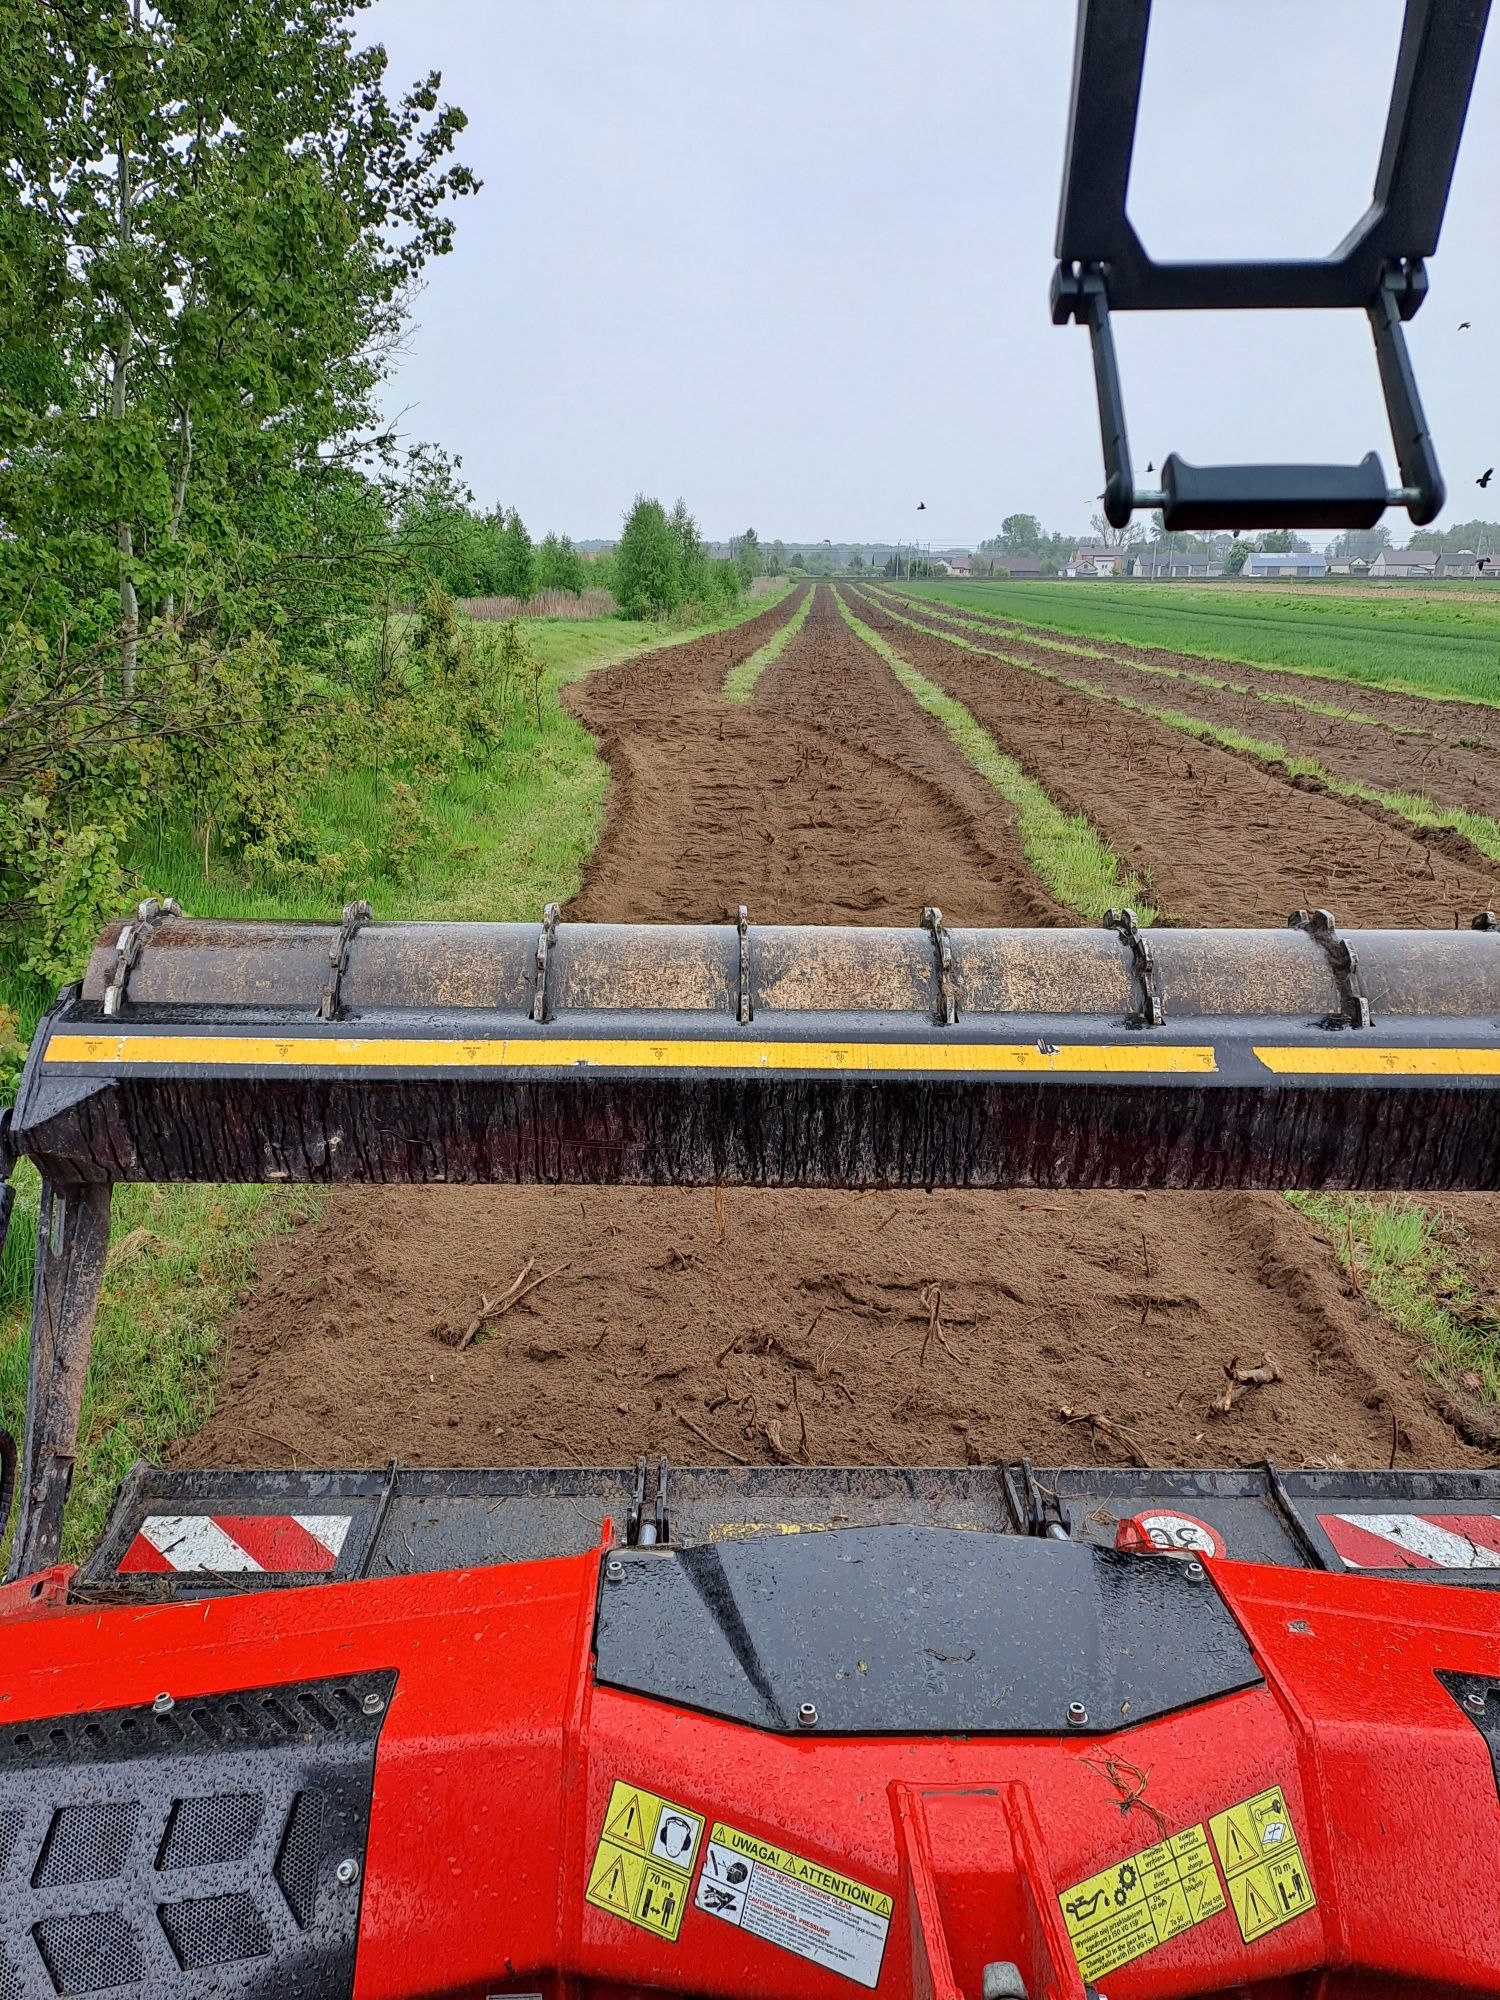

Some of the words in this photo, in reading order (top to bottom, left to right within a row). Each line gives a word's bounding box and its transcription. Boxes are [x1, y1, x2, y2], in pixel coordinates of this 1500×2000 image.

[731, 1835, 780, 1865] UWAGA!
[1187, 1852, 1199, 1862] Next
[1187, 1859, 1203, 1871] change
[1273, 1866, 1282, 1876] 70
[1283, 1863, 1291, 1872] m
[649, 1872, 661, 1886] 70
[662, 1880, 671, 1889] m
[1153, 1869, 1165, 1880] First
[799, 1864, 874, 1906] ATTENTION!
[1153, 1876, 1170, 1889] change
[1212, 1894, 1222, 1903] 500
[1150, 1903, 1157, 1911] 50
[747, 1894, 772, 1910] CAUTION
[772, 1906, 788, 1917] HIGH
[788, 1913, 797, 1921] OIL
[798, 1917, 830, 1936] PRESSURE!
[1170, 1917, 1177, 1926] To
[1176, 1914, 1183, 1922] 50
[1111, 1928, 1121, 1938] ISO
[1121, 1923, 1129, 1932] VG
[1129, 1918, 1139, 1928] 150
[1085, 1953, 1105, 1969] Change
[1116, 1942, 1126, 1952] the
[1126, 1937, 1137, 1947] gear
[1137, 1931, 1146, 1940] box
[1088, 1957, 1116, 1977] accordance
[1115, 1950, 1127, 1962] with
[1126, 1945, 1136, 1955] ISO
[1136, 1940, 1145, 1950] VG
[1144, 1935, 1154, 1945] 150
